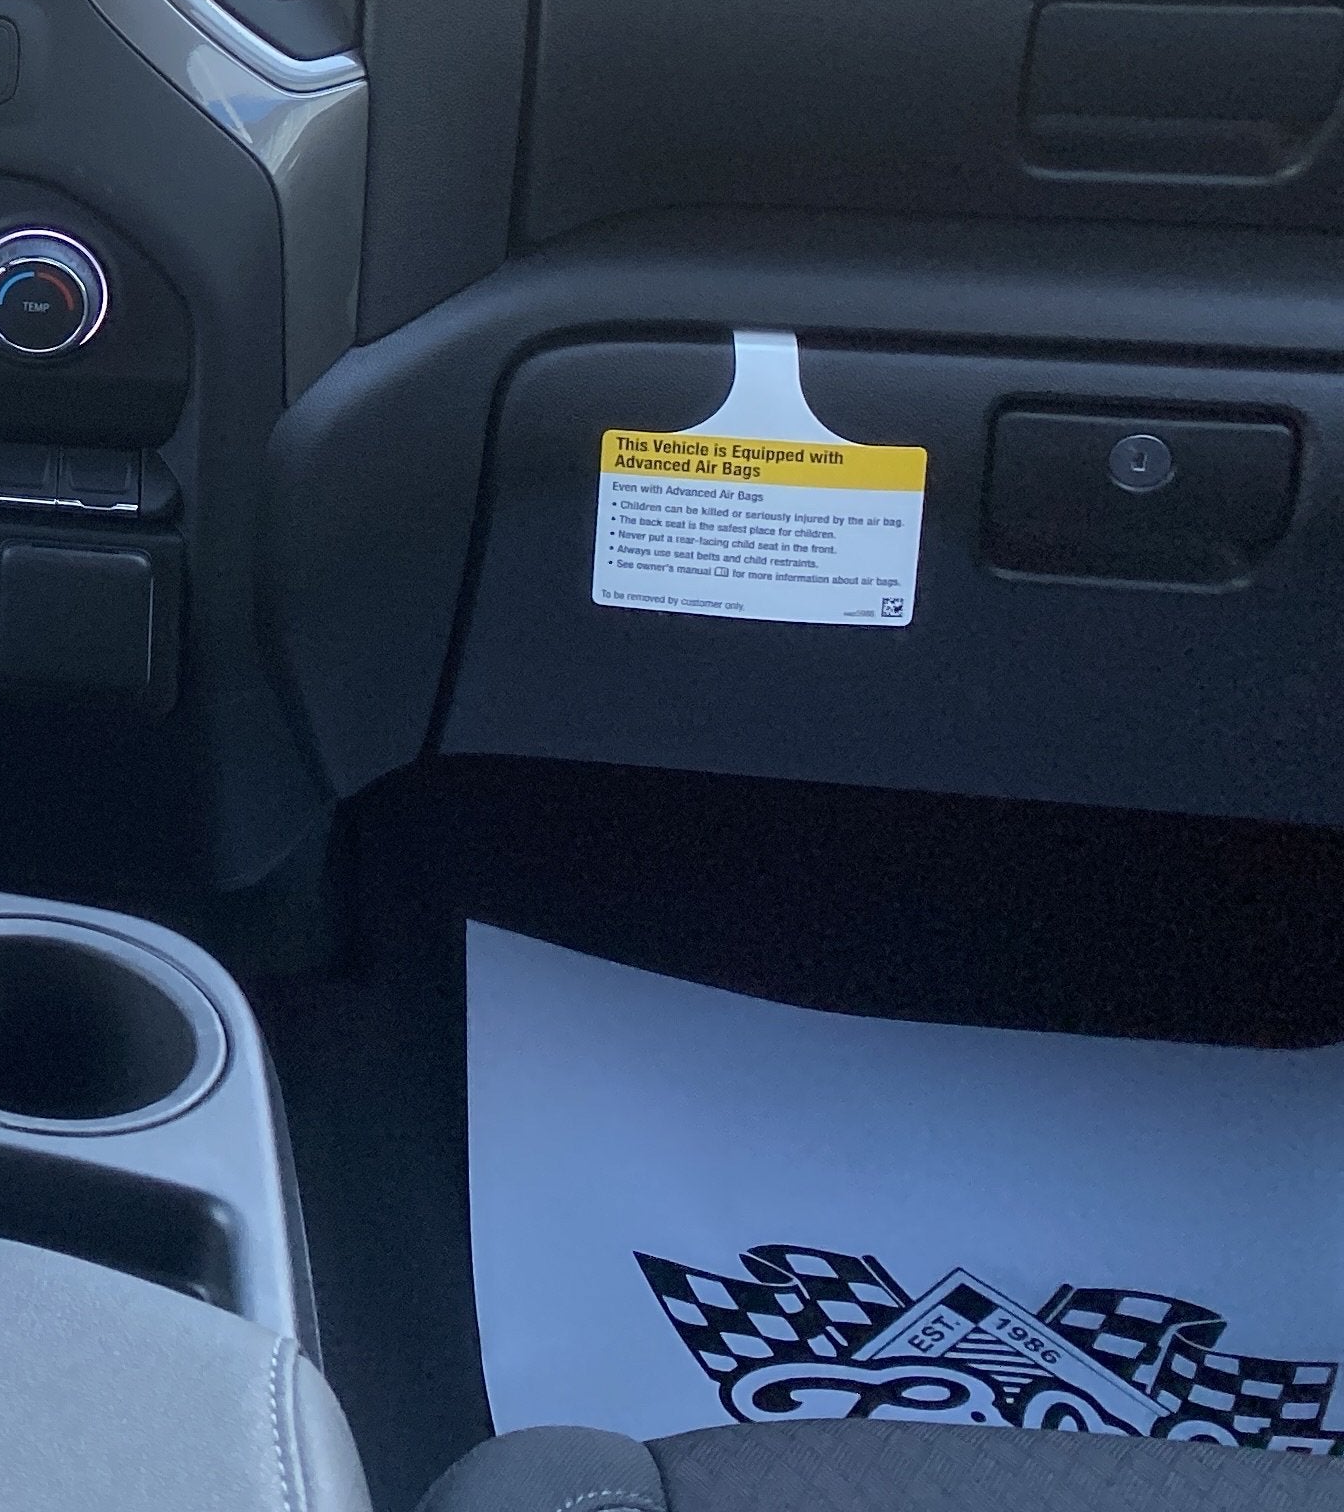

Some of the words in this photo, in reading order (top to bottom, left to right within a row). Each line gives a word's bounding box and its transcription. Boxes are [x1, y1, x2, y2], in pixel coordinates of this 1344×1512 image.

[22, 301, 50, 313] TEMP
[616, 436, 649, 452] This
[653, 439, 709, 456] Vehicle
[714, 443, 727, 457] is
[732, 444, 805, 464] Equipped
[809, 450, 844, 465] with
[614, 454, 691, 472] Advanced
[695, 459, 718, 474] Air
[722, 461, 761, 479] Bags
[612, 481, 638, 493] Even
[640, 484, 663, 495] with
[665, 485, 717, 499] Advanced
[719, 489, 734, 500] Air
[737, 490, 764, 503] Bags
[619, 515, 636, 525] The
[639, 517, 662, 527] back
[665, 519, 686, 529] seat
[688, 520, 697, 530] is
[699, 521, 714, 531] the
[717, 523, 747, 534] safest
[749, 525, 776, 536] place
[778, 527, 792, 537] for
[620, 500, 662, 512] Children
[664, 504, 683, 513] can
[686, 505, 698, 515] be
[701, 507, 729, 518] killed
[732, 510, 743, 519] or
[745, 510, 791, 523] seriously
[794, 513, 830, 524] injured
[833, 515, 845, 527] by
[848, 516, 864, 525] the
[867, 517, 881, 526] air
[618, 530, 646, 541] Never
[648, 533, 664, 543] put
[675, 535, 729, 548] rear-facing
[732, 539, 755, 549] child
[758, 542, 779, 551] seat
[781, 542, 790, 551] in
[793, 543, 809, 553] the
[617, 544, 651, 557] Always
[653, 548, 671, 557] use
[673, 550, 694, 559] seat
[696, 551, 720, 561] belts
[723, 554, 741, 563] and
[743, 555, 767, 565] child
[770, 557, 819, 569] restraints.
[617, 559, 634, 569] See
[636, 562, 674, 573] owner's
[676, 564, 712, 576] manual
[732, 568, 746, 578] for
[748, 571, 773, 581] more
[775, 572, 829, 584] information
[832, 575, 859, 585] about
[861, 577, 875, 586] air
[602, 589, 611, 599] To
[614, 590, 625, 600] be
[627, 592, 665, 604] removed
[667, 595, 678, 606] by
[681, 597, 723, 609] customer
[908, 1315, 961, 1353] EST.
[996, 1317, 1061, 1364] 1986
